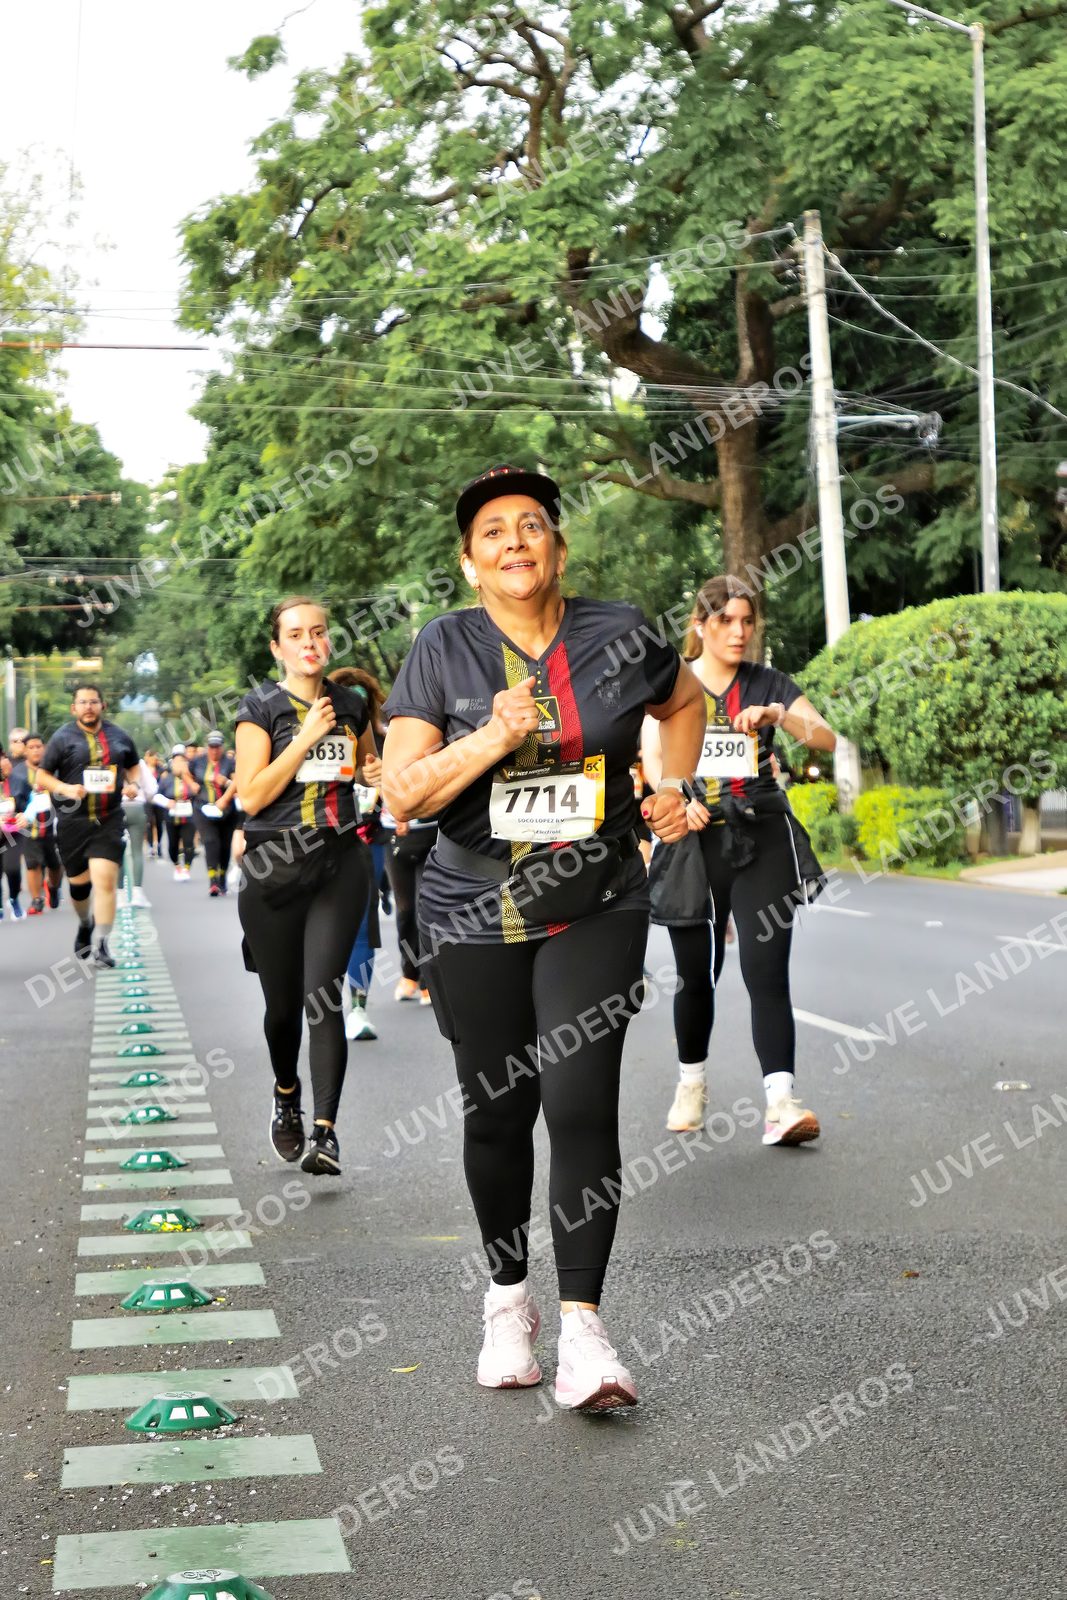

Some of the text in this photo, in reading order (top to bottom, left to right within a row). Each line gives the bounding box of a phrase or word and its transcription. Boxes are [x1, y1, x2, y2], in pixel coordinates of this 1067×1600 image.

[703, 741, 745, 757] 5590
[586, 762, 599, 771] 5K
[505, 784, 579, 814] 7714
